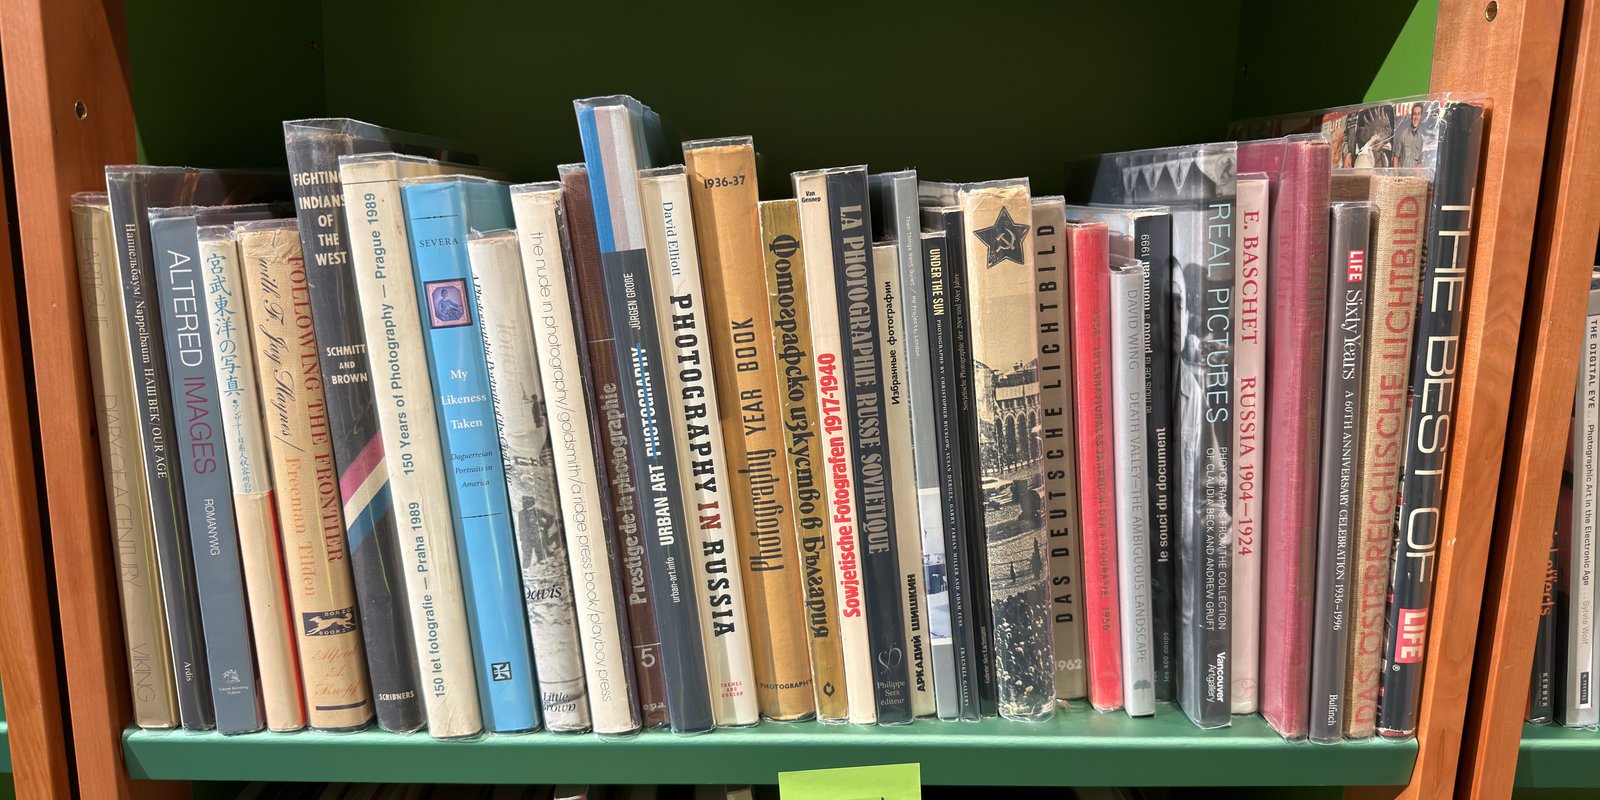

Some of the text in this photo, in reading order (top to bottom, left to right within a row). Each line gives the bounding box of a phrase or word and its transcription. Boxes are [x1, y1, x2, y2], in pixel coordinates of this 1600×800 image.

[299, 194, 346, 210] INDIANS
[318, 214, 333, 227] OF
[704, 175, 746, 189] 1936-37
[315, 252, 347, 266] WEST
[318, 233, 340, 246] THE
[419, 237, 460, 248] SEVERA
[661, 200, 682, 276] David Elliott
[904, 231, 913, 251] Things
[1140, 233, 1150, 257] 1999
[1240, 209, 1259, 345] E. BASCHET
[79, 234, 109, 330] LARTIGUE
[262, 297, 284, 327] F.
[625, 299, 643, 331] JÜRGEN
[907, 269, 916, 286] Quiet
[928, 248, 944, 316] UNDER THE SUN
[1205, 203, 1230, 423] REAL PICTURES
[1340, 250, 1363, 380] LIFE Sixty Years
[167, 247, 216, 475] ALTERED IMAGES
[205, 251, 245, 397] 宮武東洋の写真
[326, 344, 366, 356] SCHMITT
[363, 191, 415, 475] 150 Years of Photography Prague 1989
[882, 280, 901, 404] Избранные фотографии
[1126, 289, 1139, 370] DAVID WING
[331, 372, 368, 385] BROWN
[339, 361, 356, 370] AND
[440, 393, 486, 406] Likeness
[450, 369, 468, 381] My
[839, 205, 889, 554] LA PHOTOGRAPHIE RUSSE SOVIETIQUE
[935, 319, 952, 472] PHOTOGRAPHS BY CHRISTOPHER SUSAN
[1403, 185, 1474, 583] THE BEST OF
[1587, 319, 1597, 409] THE DIGITAL EYE
[142, 366, 167, 479] НАШ AGE
[284, 255, 347, 563] FOLLOWING THE FRONTIER
[450, 418, 483, 430] Taken
[631, 344, 675, 546] URBAN ART PHOTOGRAPHY
[730, 317, 790, 573] Photography YEAR BOOK
[766, 232, 833, 639] Фотографско изкуство в България
[1036, 224, 1072, 623] DAS DEUTSCHE LICHTBILD
[1238, 376, 1255, 457] RUSSIA
[1342, 400, 1353, 430] 60TH
[97, 393, 140, 590] DIARY CENTURY
[462, 479, 490, 488] America
[529, 231, 612, 702] the nude ridge press press
[598, 380, 650, 605] Prestige de la photographie
[668, 293, 736, 637] PHOTOGRAPHY IN RUSSIA
[817, 352, 862, 618] Sowjetische Fotografen 1917-1940
[1153, 426, 1169, 561] le souci du document
[1338, 432, 1352, 508] ANNIVERSARY
[1353, 671, 1379, 725] DAS
[1381, 194, 1420, 360] LICHTBILD
[1583, 423, 1594, 569] Photographic Art the Electronic
[203, 498, 219, 555] ROMANYWG
[283, 455, 320, 597] Freeman Tilden
[1128, 392, 1147, 663] DEATH AMBIGUOUS LANDSCAPE
[1204, 463, 1214, 631] CLAUDIA BECK AND ANDREW GRUFT
[1217, 447, 1227, 629] PHOTOGRAPHS FROM THE COLLECTION
[1334, 509, 1348, 580] CELEBRATION
[407, 500, 446, 698] 150 let fotografie Praha 1989
[906, 573, 925, 692] АРКАДИЙ ШИШКИН
[1399, 608, 1426, 662] LIFE
[130, 641, 156, 703] VIKING
[182, 661, 193, 681] Ardis
[312, 642, 358, 662] Alfred
[314, 680, 360, 698] Knopf
[641, 648, 656, 668] 5
[877, 680, 905, 689] Philippe
[1216, 651, 1225, 702] Vancouver
[378, 690, 414, 701] SCRIBNERS
[1326, 693, 1338, 726] Bulfinch
